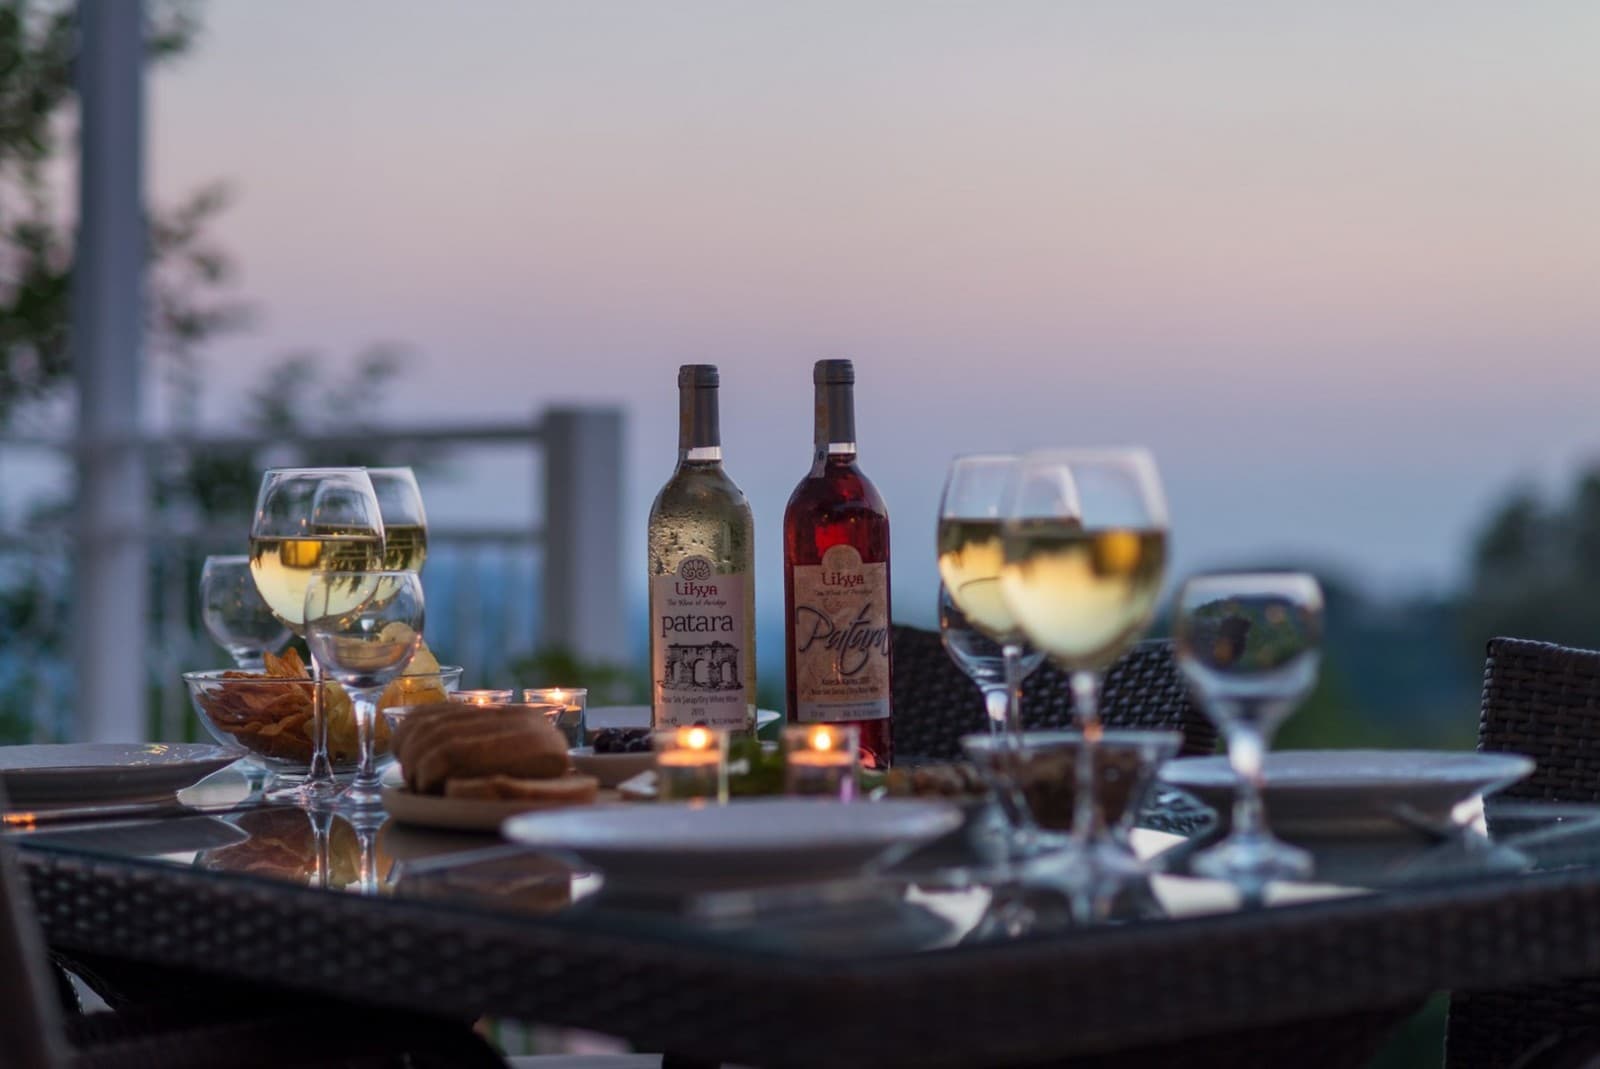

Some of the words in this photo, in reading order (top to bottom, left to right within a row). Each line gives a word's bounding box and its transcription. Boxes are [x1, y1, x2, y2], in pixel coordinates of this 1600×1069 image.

[822, 572, 864, 587] Likya
[675, 582, 718, 597] Likya
[661, 613, 734, 639] patara
